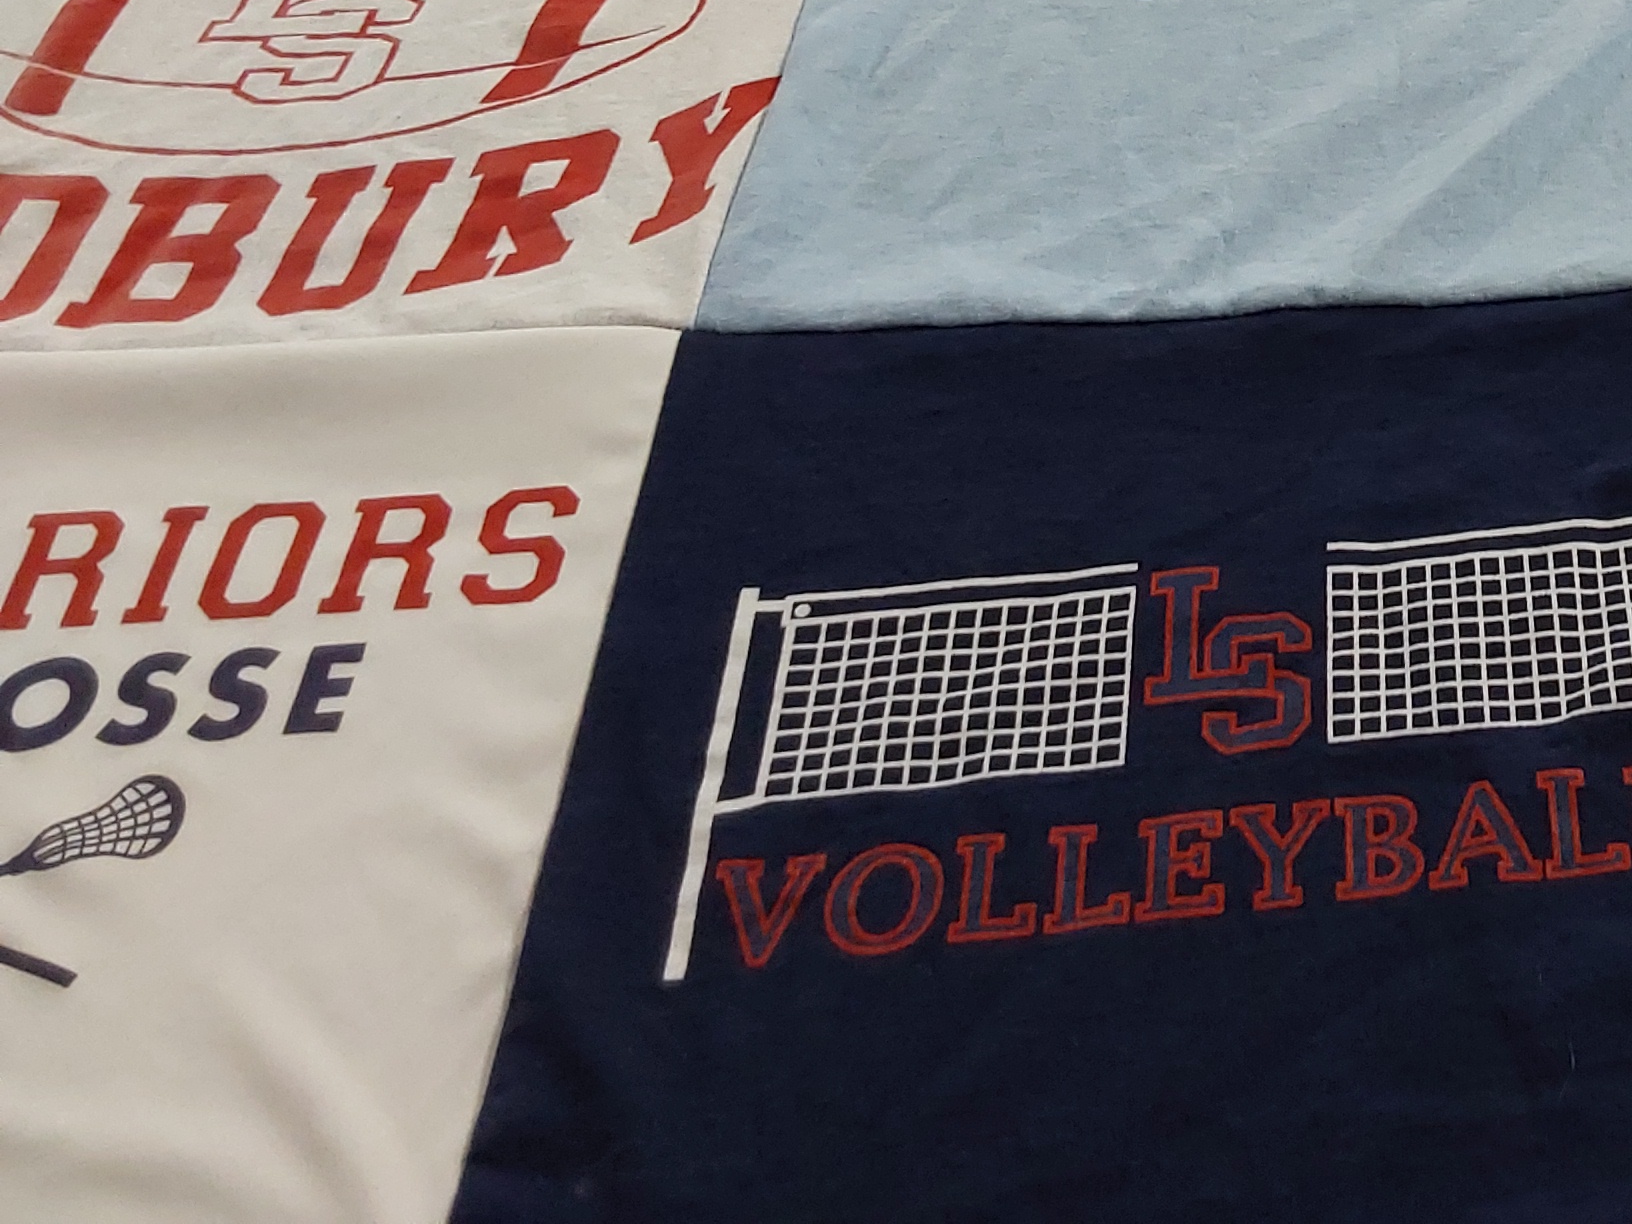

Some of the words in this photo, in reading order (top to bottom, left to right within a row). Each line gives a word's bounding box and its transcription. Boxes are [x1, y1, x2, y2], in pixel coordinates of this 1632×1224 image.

[0, 484, 580, 631] RIORS
[0, 642, 367, 753] OSSE
[1144, 565, 1315, 755] LS
